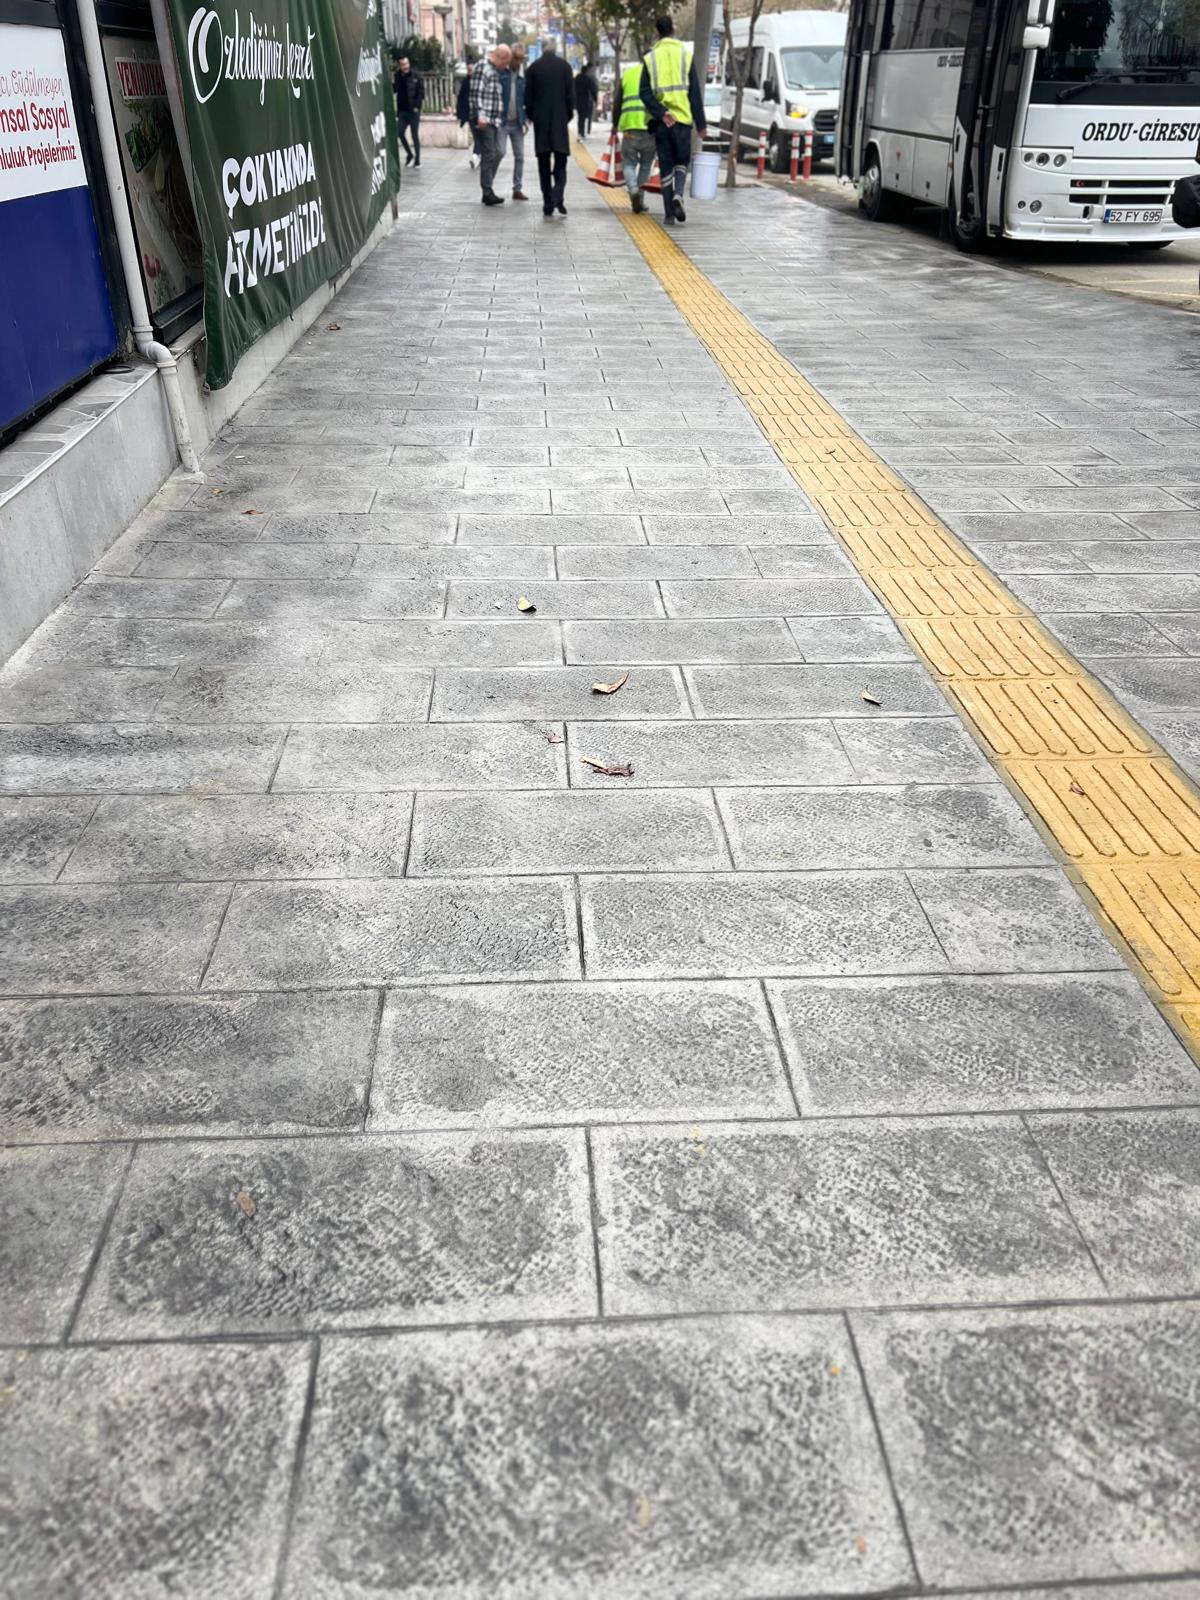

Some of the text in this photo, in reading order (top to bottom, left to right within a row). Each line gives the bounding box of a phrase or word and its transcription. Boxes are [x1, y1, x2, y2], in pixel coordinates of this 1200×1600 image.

[30, 100, 71, 138] Sosyal
[27, 139, 77, 171] Projelerimiz
[222, 154, 268, 219] ÇOK
[1110, 211, 1161, 222] 52 FY 695
